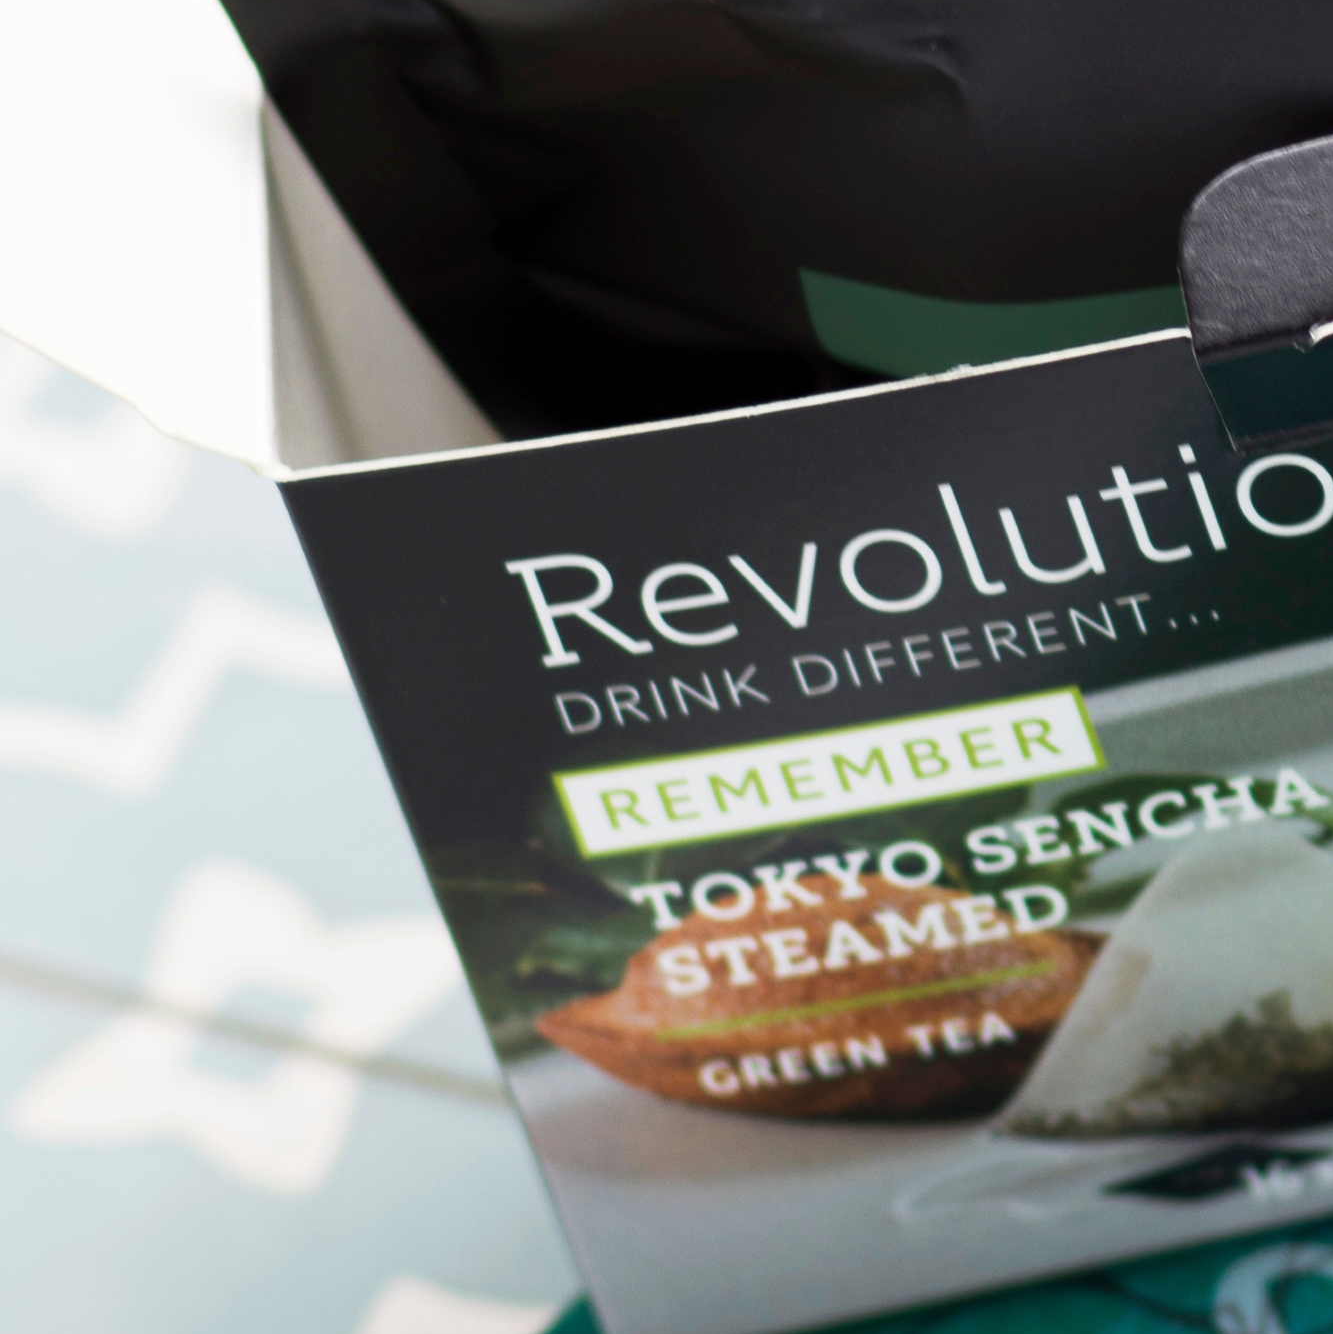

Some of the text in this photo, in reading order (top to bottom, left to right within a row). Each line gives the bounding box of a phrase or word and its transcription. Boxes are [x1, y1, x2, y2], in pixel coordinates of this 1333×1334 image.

[555, 593, 1222, 735] DRINK DIFFERENT...
[597, 714, 1064, 833] REMEMBER
[631, 766, 1332, 931] TOKYO SENCHA
[657, 883, 1070, 997] STEAMED
[698, 1011, 1015, 1098] GREEN TEA
